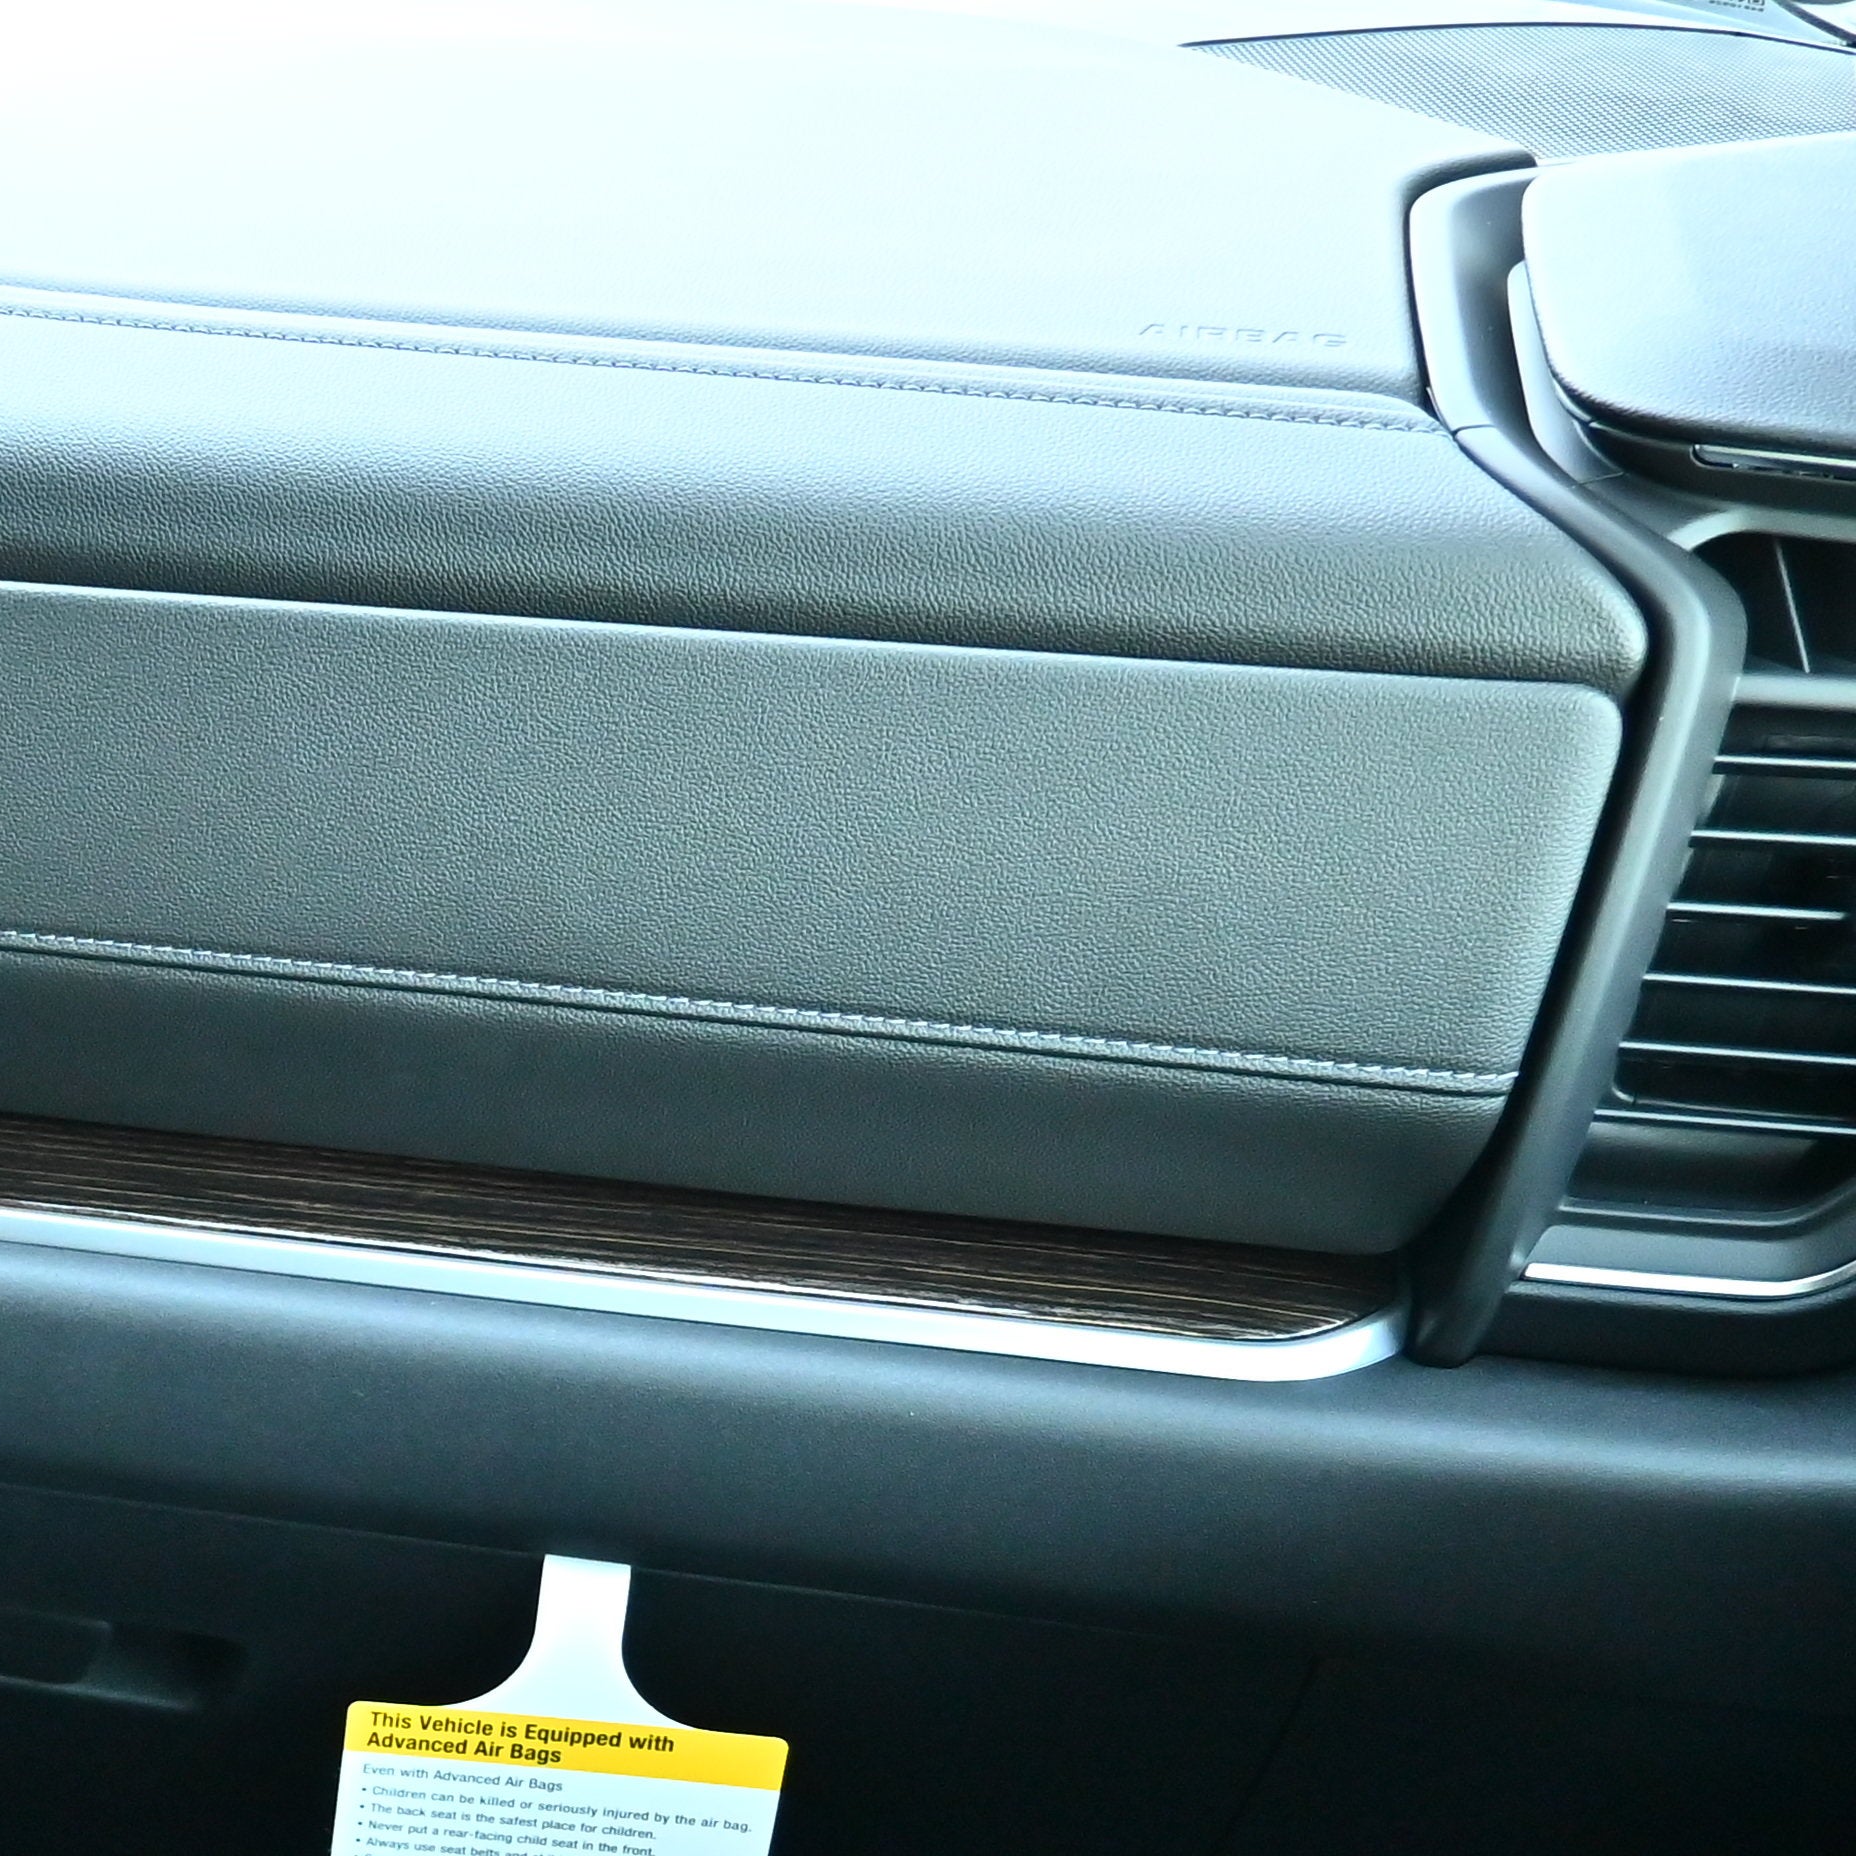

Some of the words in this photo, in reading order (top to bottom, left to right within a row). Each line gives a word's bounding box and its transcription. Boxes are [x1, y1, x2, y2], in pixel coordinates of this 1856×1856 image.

[1138, 323, 1348, 348] AIRBAG
[367, 1731, 468, 1755] Advanced
[474, 1740, 504, 1757] Air
[510, 1743, 562, 1765] Bags
[371, 1711, 412, 1729] This
[419, 1715, 493, 1737] Vehicle
[500, 1721, 517, 1738] is
[524, 1723, 622, 1748] Equipped
[629, 1734, 675, 1752] with
[363, 1763, 395, 1776] Even
[400, 1767, 429, 1779] with
[433, 1770, 500, 1786] Advanced
[505, 1776, 524, 1788] Air
[529, 1778, 563, 1793] Bags
[371, 1802, 394, 1815] The
[397, 1806, 426, 1817] back
[431, 1810, 457, 1820] seat
[461, 1812, 471, 1821] is
[476, 1813, 495, 1824] the
[499, 1815, 538, 1828] safest
[542, 1819, 576, 1832] place
[580, 1822, 597, 1833] for
[601, 1824, 656, 1840] children.
[372, 1785, 427, 1800] Children
[431, 1793, 454, 1802] can
[459, 1794, 475, 1805] be
[480, 1796, 515, 1808] killed
[520, 1800, 533, 1809] or
[538, 1802, 598, 1818] seriously
[602, 1807, 649, 1822] injured
[654, 1812, 669, 1825] by
[675, 1814, 696, 1826] the
[700, 1817, 719, 1829] air
[723, 1820, 752, 1833] bag.
[366, 1837, 409, 1851] Always
[414, 1843, 436, 1852] use
[440, 1844, 466, 1855] seat
[369, 1820, 404, 1833] Never
[408, 1825, 428, 1836] put
[432, 1828, 439, 1836] a
[443, 1827, 513, 1845] rear-facing
[517, 1834, 547, 1847] child
[552, 1839, 578, 1850] seat
[582, 1841, 594, 1851] in
[598, 1842, 618, 1854] the
